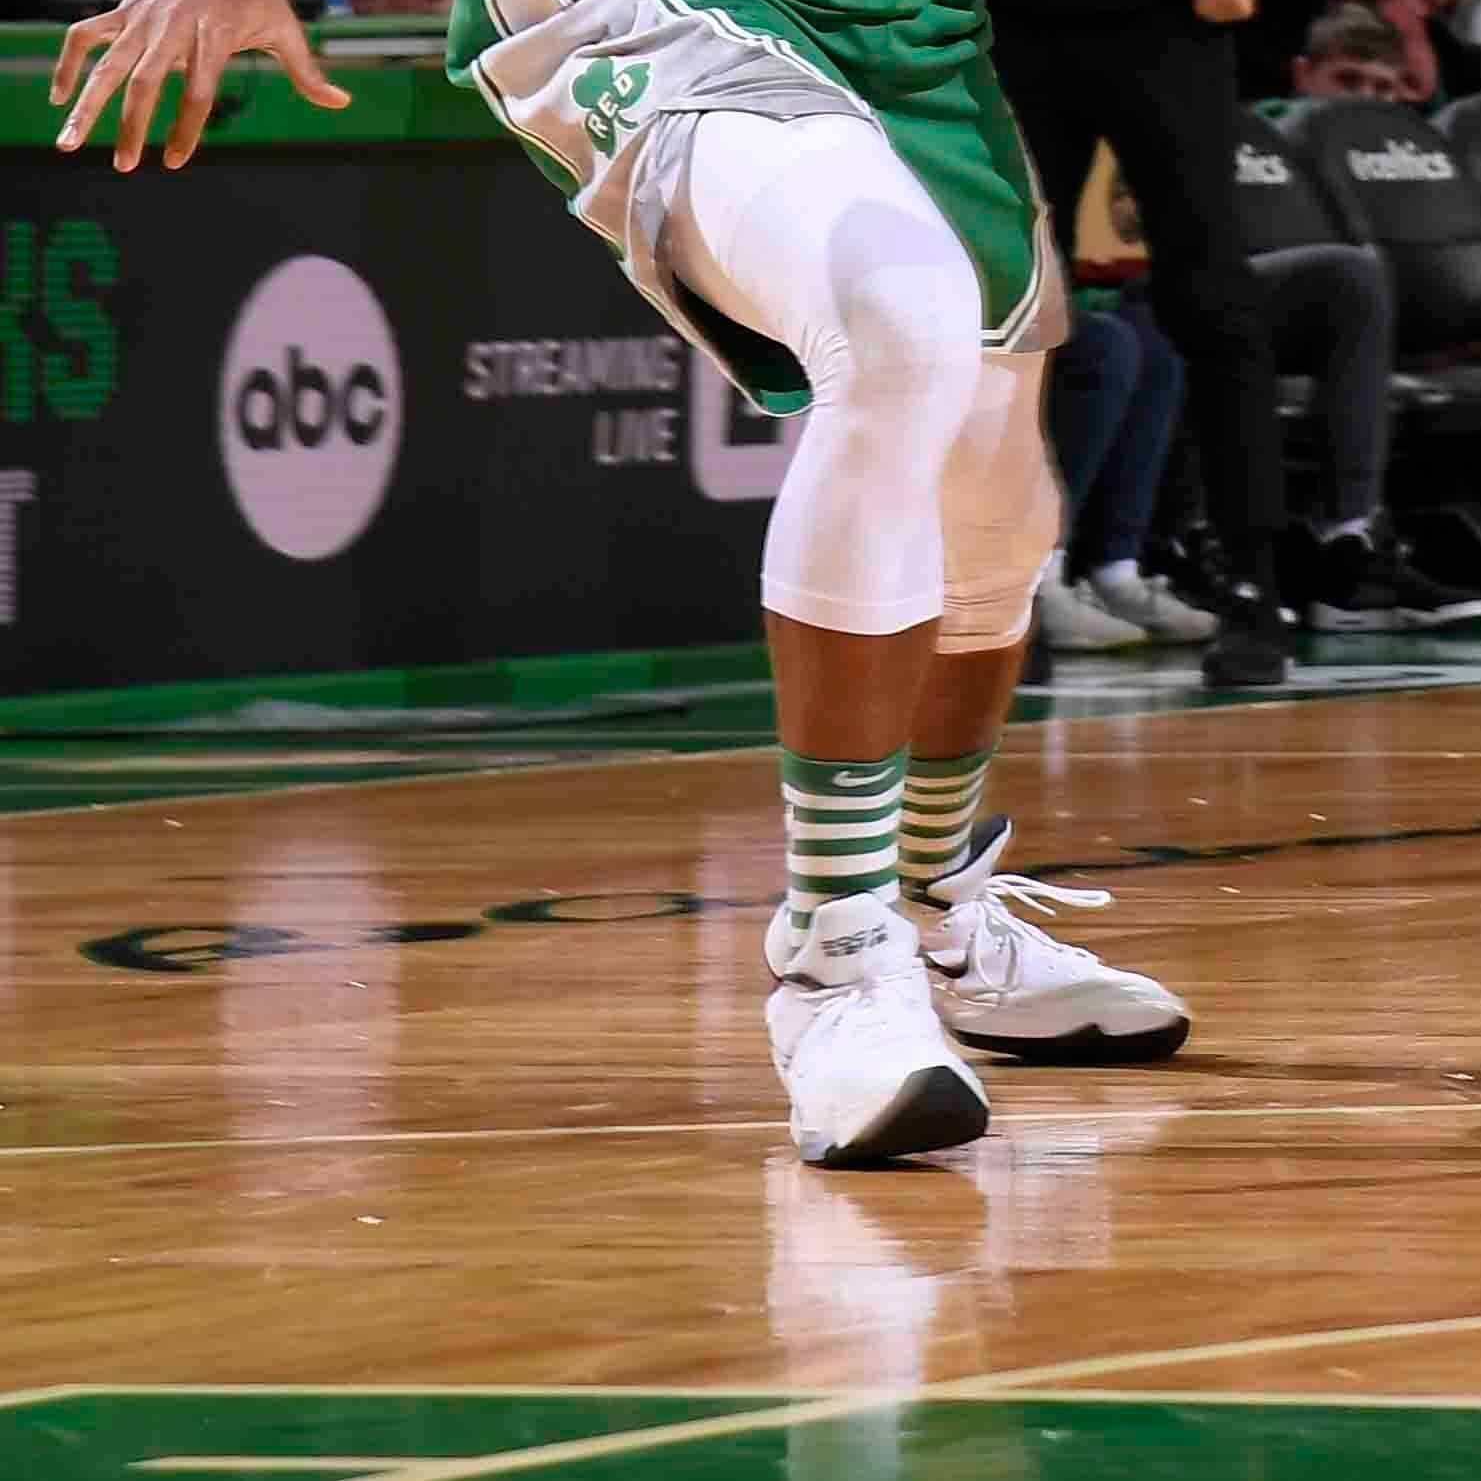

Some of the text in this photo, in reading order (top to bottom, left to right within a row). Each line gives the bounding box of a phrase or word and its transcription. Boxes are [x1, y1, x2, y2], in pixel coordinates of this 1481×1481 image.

[586, 71, 634, 140] RED
[239, 345, 386, 450] abc
[463, 337, 681, 400] STREAMING
[593, 408, 680, 467] LIVE
